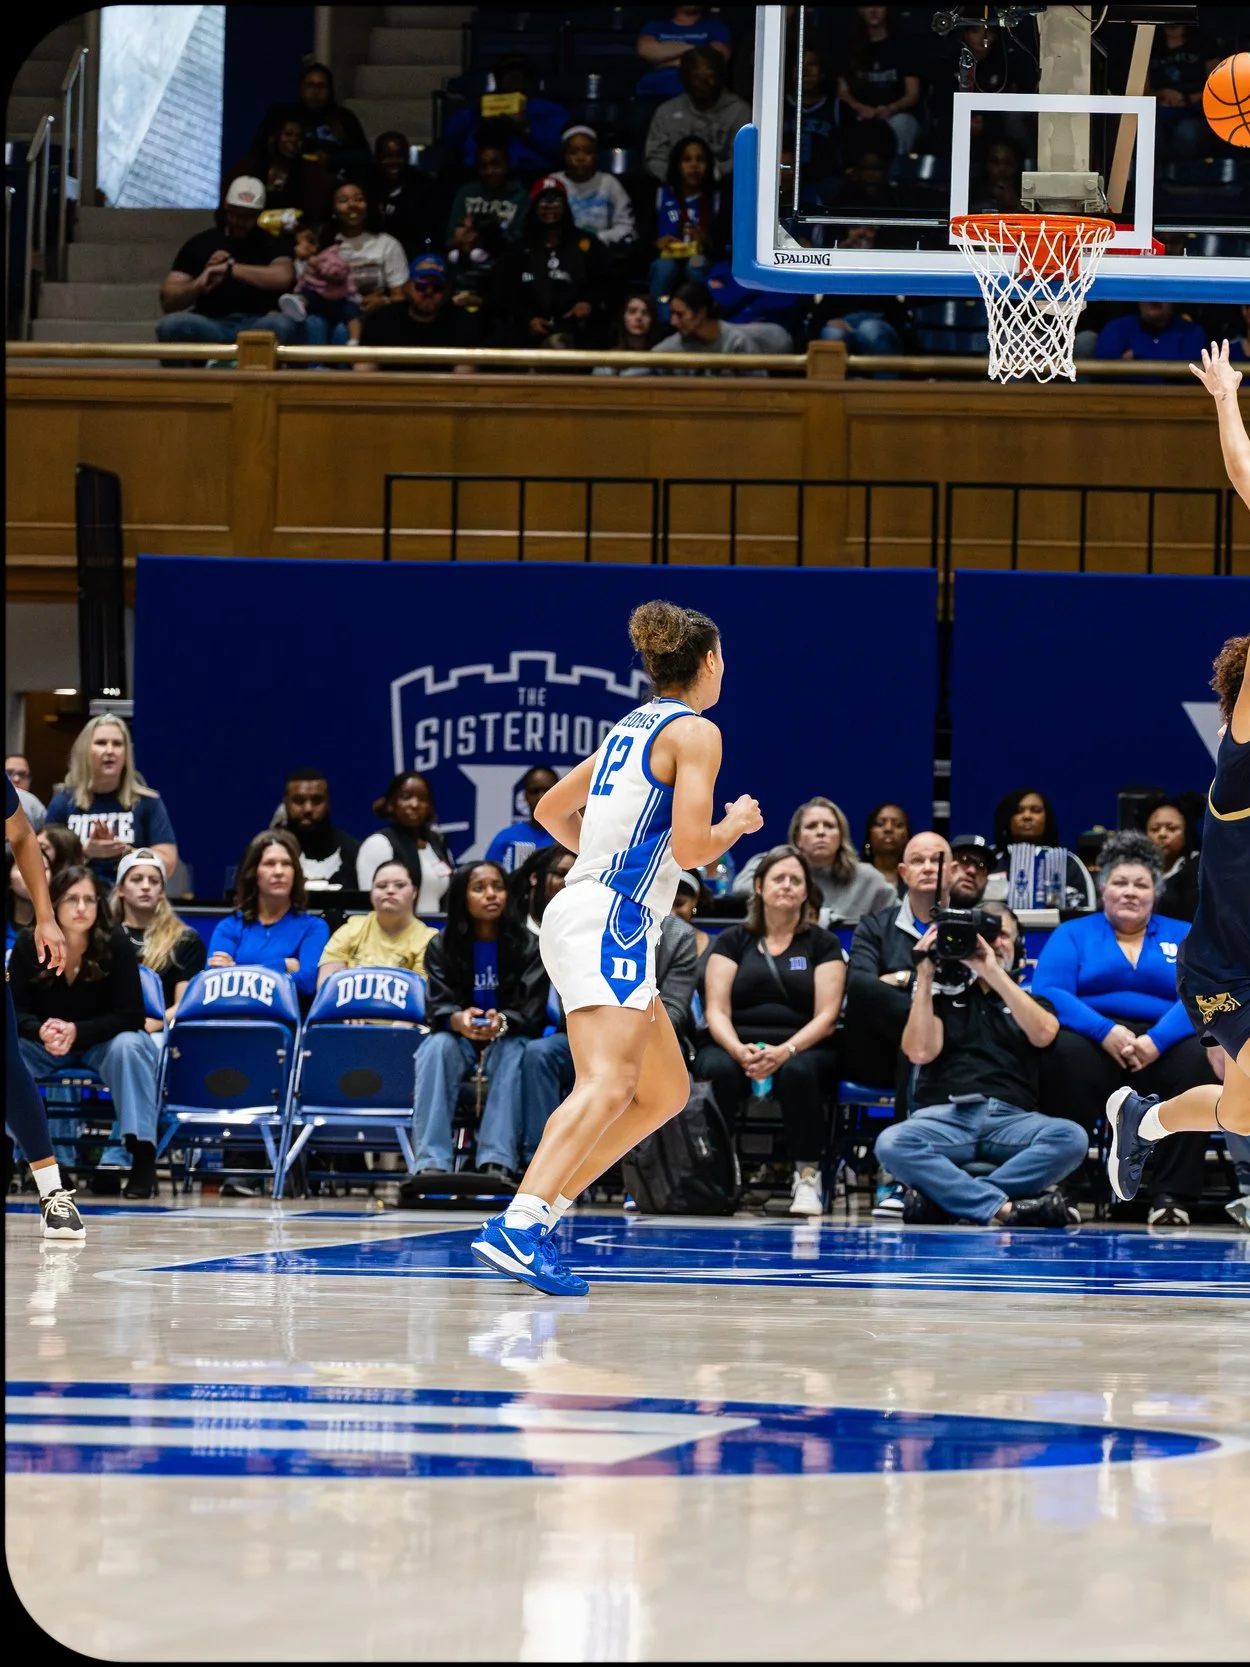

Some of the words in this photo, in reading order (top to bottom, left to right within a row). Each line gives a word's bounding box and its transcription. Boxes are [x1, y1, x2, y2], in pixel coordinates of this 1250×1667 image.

[774, 252, 832, 266] SPALDING
[518, 687, 547, 706] THE
[591, 734, 635, 796] 12
[610, 956, 637, 981] D
[203, 973, 276, 1007] DUKE
[336, 974, 409, 1010] DUKE
